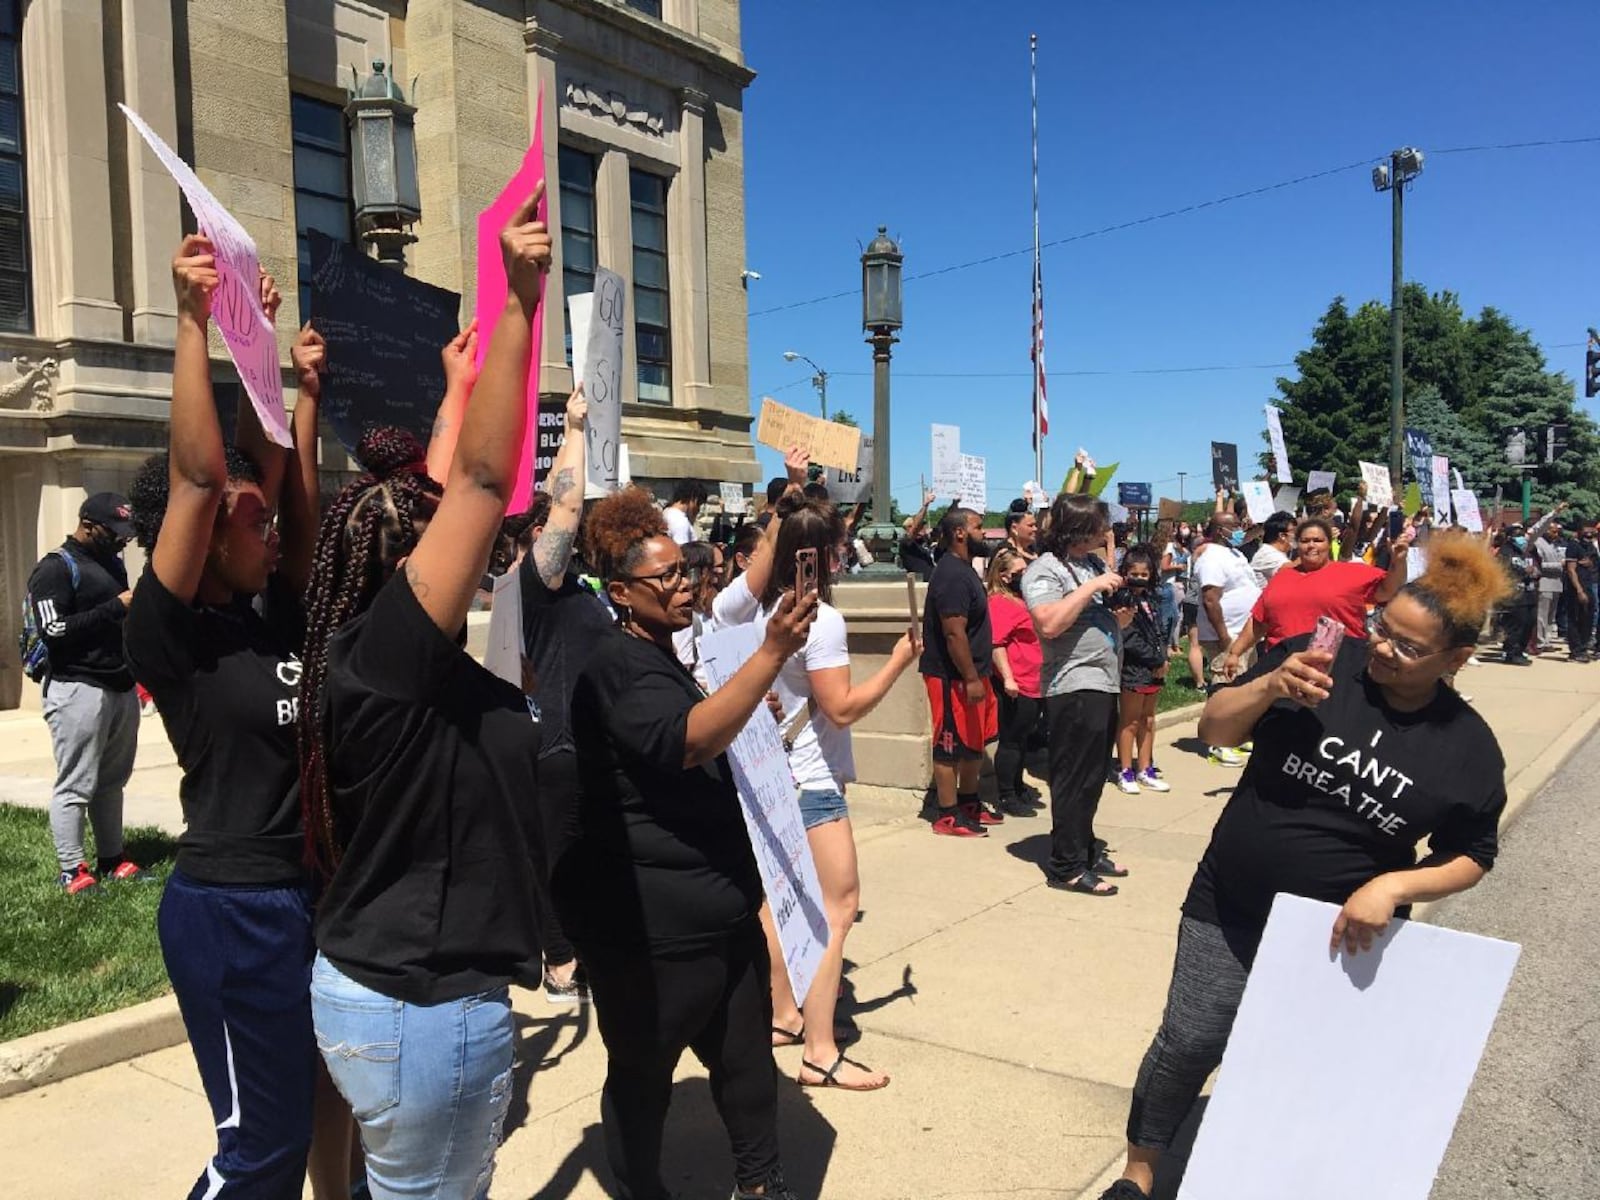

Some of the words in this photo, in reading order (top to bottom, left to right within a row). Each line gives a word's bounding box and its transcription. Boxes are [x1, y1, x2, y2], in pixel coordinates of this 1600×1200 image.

[1319, 736, 1414, 799] CAN'T
[1369, 729, 1383, 748] I
[1282, 752, 1408, 836] BREATHE
